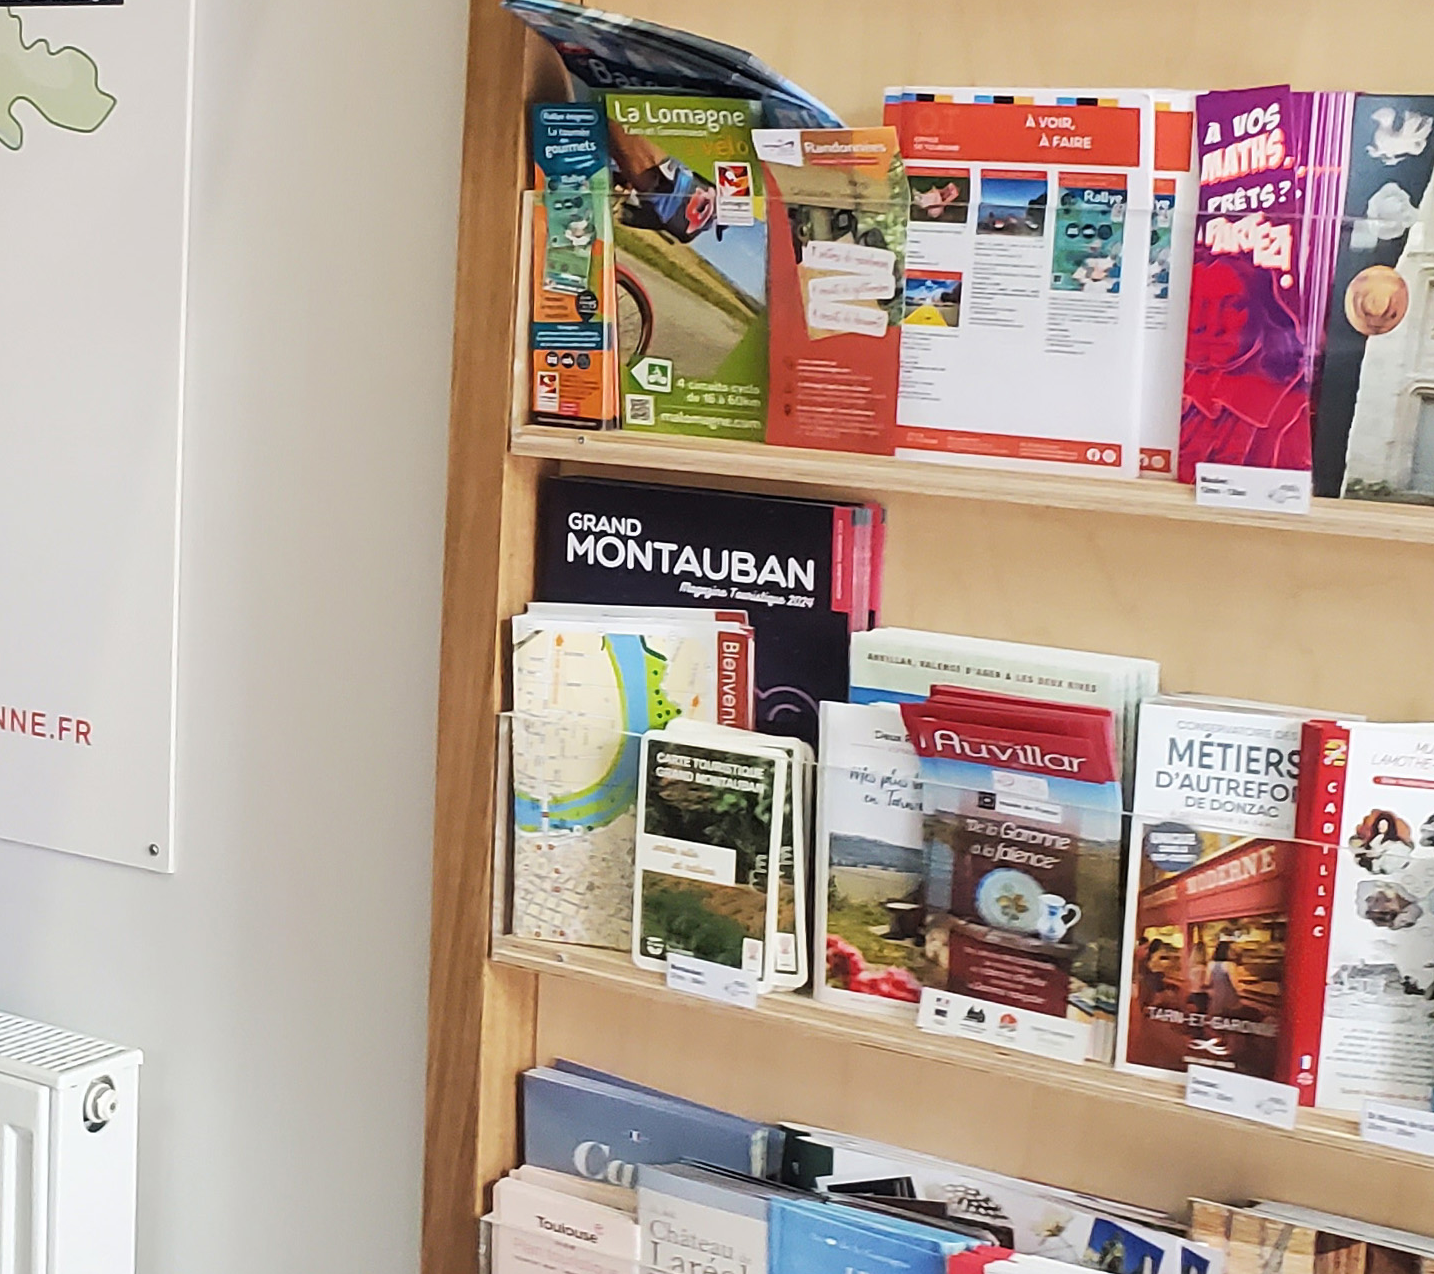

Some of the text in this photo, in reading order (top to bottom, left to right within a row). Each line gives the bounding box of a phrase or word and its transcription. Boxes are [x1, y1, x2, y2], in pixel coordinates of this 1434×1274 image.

[614, 101, 745, 133] La Lomagne
[1025, 113, 1076, 130] À VOIR,
[1232, 102, 1281, 137] VOS
[545, 140, 597, 158] gourmets
[702, 133, 749, 156] vélo
[1039, 133, 1092, 150] À FAIRE
[1084, 189, 1124, 204] Rallye
[567, 511, 642, 538] GRAND
[566, 531, 816, 592] MONTAUBAN
[656, 751, 766, 780] CARTE TOURISTIQUE
[934, 729, 1088, 774] Auvillar
[1167, 732, 1301, 781] MÉTIERS
[655, 766, 765, 795] GRAND MONTAUBAN
[1184, 796, 1280, 819] DE DONZAC
[1000, 821, 1071, 850] Garonne
[535, 1214, 599, 1244] Toulouse
[649, 1219, 734, 1260] Château
